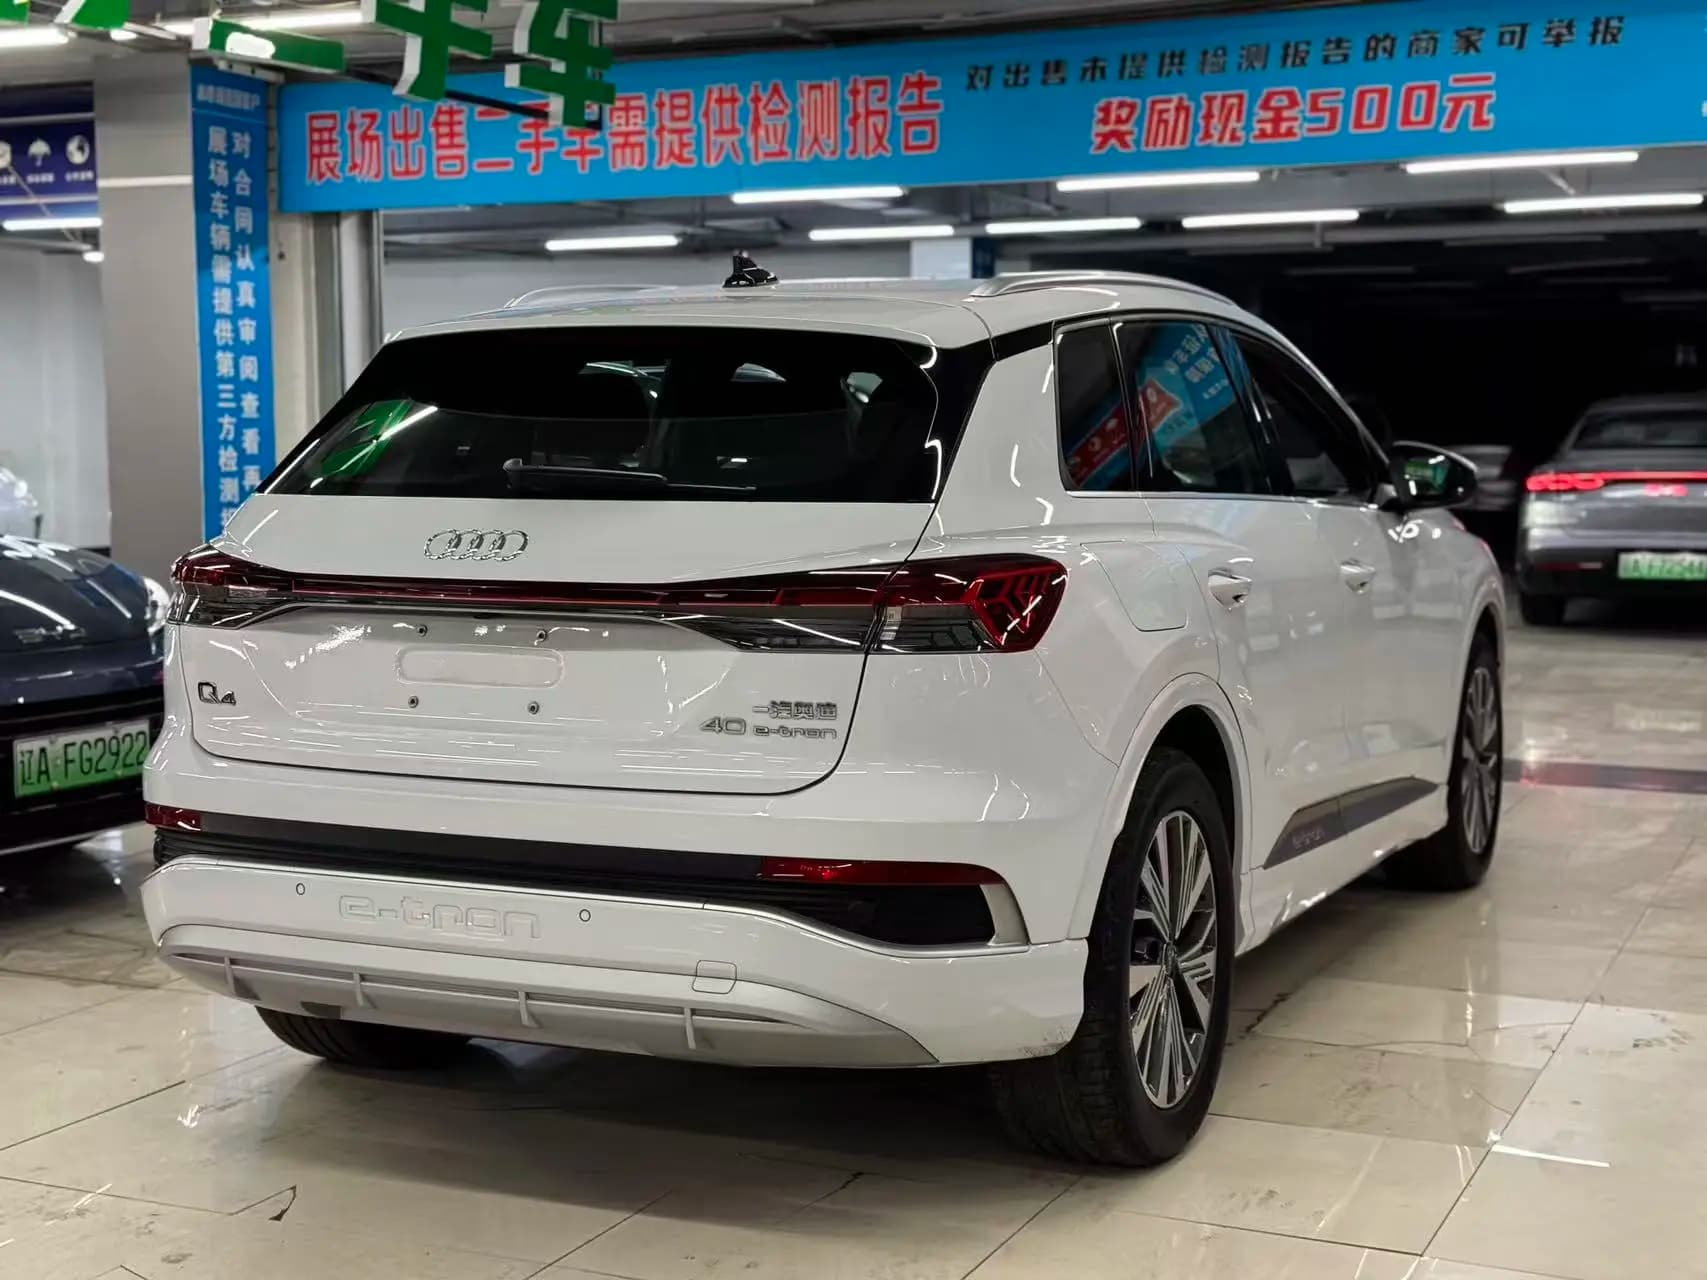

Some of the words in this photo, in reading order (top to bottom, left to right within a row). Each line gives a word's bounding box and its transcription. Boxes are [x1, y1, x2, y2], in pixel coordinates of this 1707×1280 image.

[966, 15, 1626, 90] 对出售未提供检测报告的商家可举报
[1090, 72, 1496, 155] 奖励现金500元
[197, 681, 237, 706] Q4
[699, 716, 747, 736] 40
[752, 725, 838, 740] e-tron
[338, 893, 542, 939] e-tron
